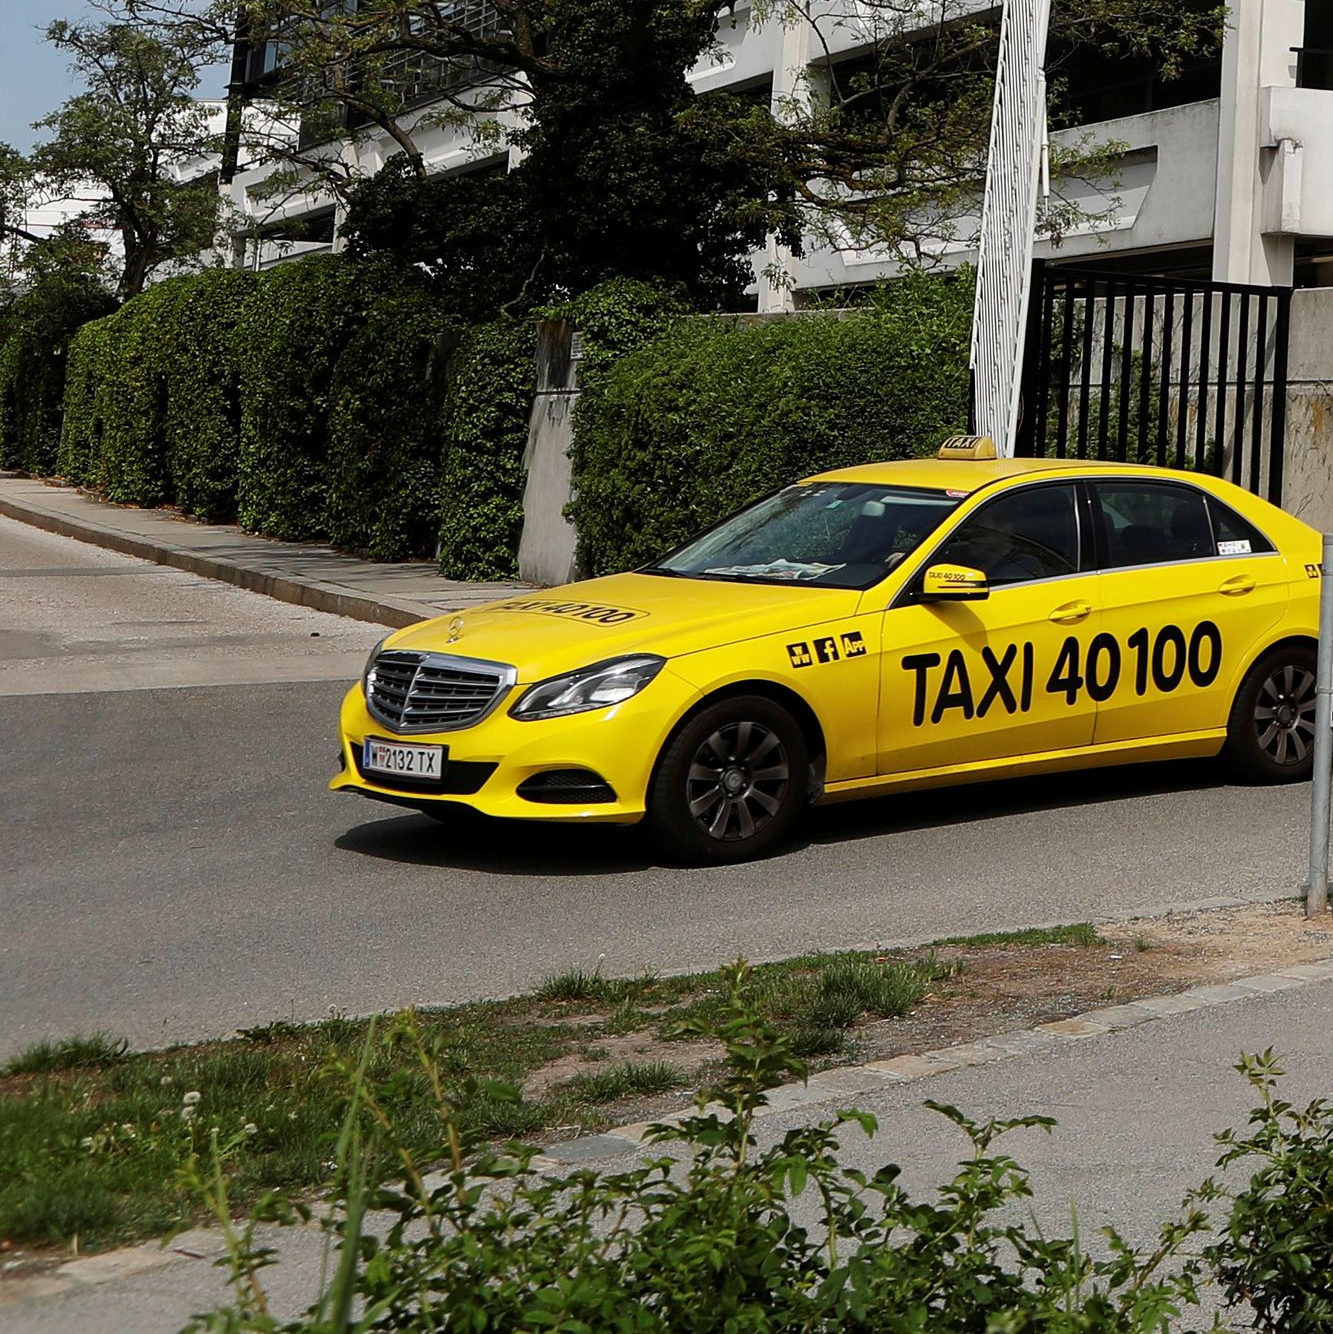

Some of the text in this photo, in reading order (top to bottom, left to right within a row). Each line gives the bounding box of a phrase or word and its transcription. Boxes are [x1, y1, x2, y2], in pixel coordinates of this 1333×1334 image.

[947, 436, 979, 448] TAXI
[901, 641, 1034, 727] TAXI
[385, 748, 414, 770] 2132
[418, 752, 435, 773] TX
